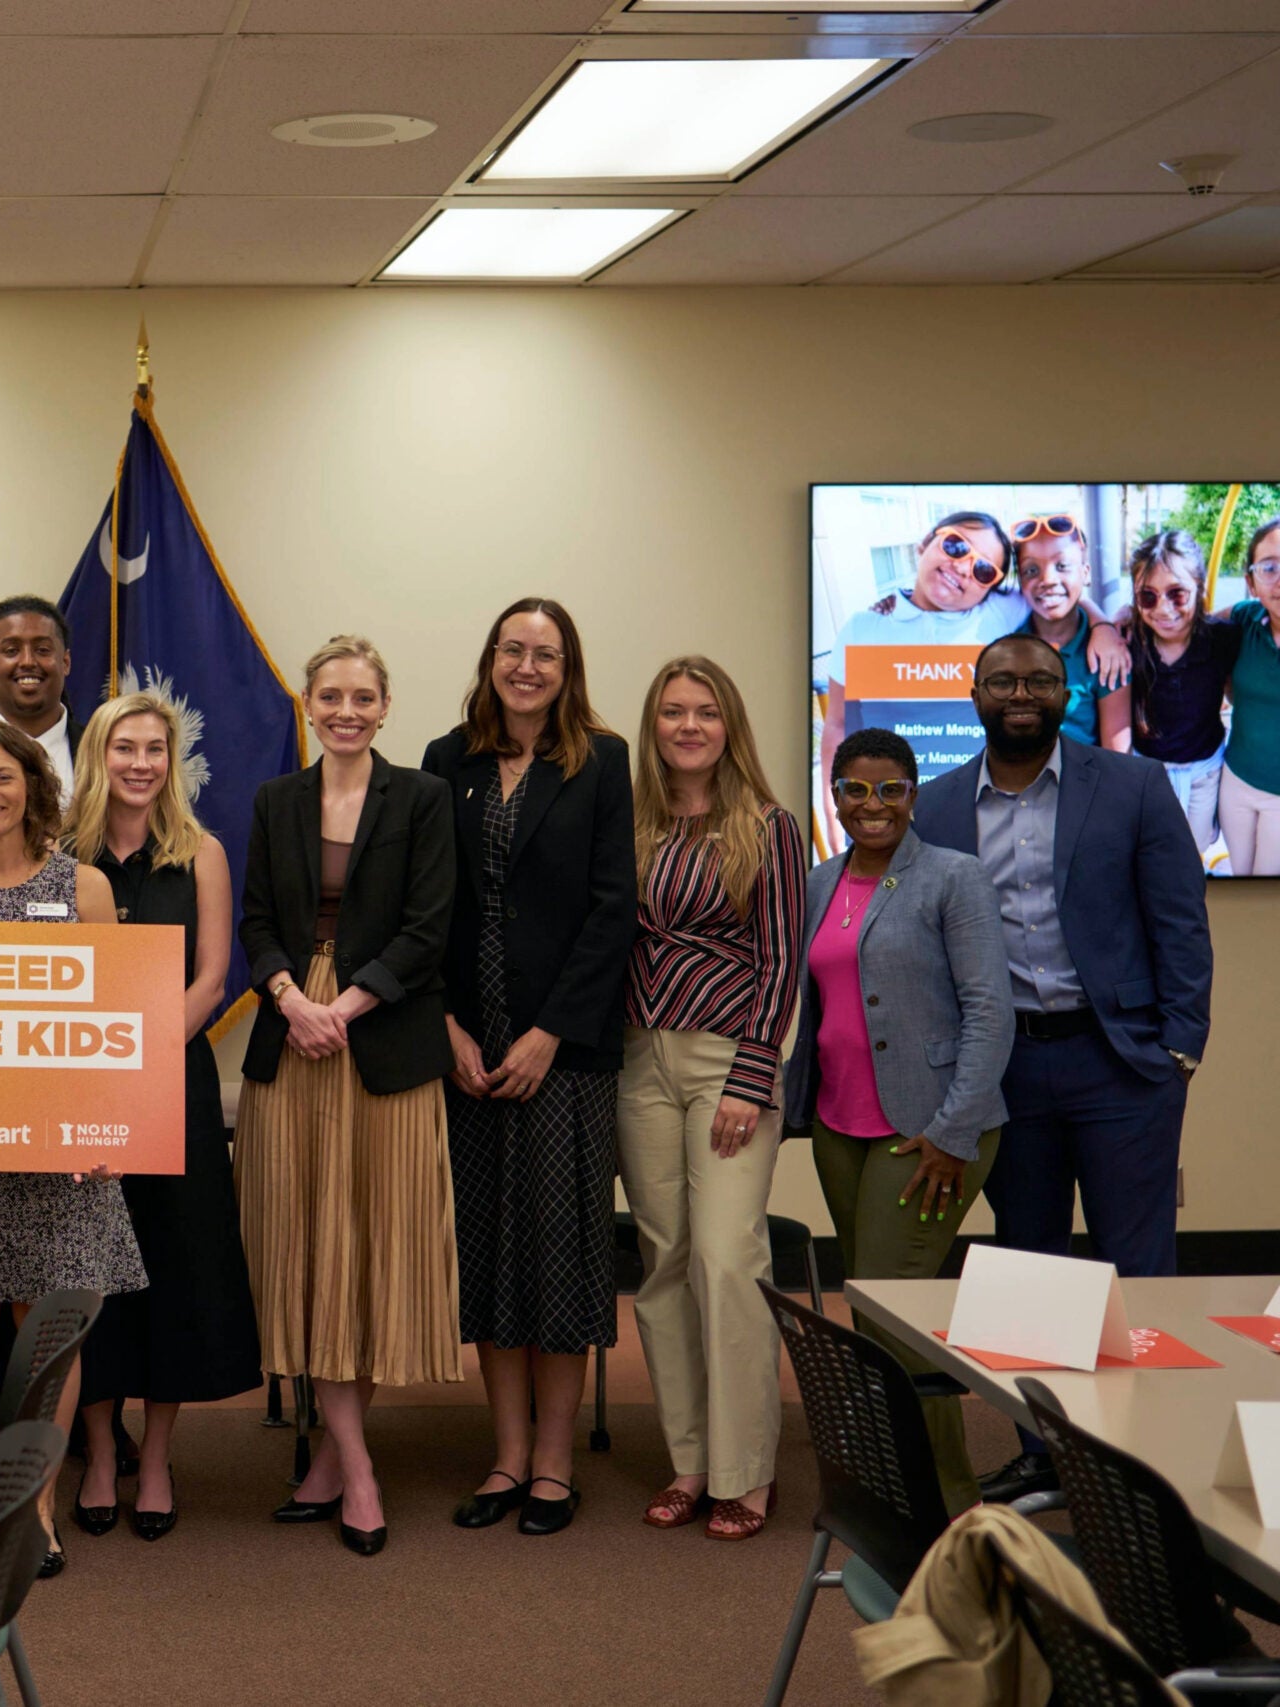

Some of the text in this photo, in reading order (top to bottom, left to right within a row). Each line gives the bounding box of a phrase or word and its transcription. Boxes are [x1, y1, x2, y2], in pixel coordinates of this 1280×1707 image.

[892, 663, 964, 681] THANK
[894, 723, 943, 736] Mathew
[17, 1021, 136, 1059] KIDS
[77, 1123, 130, 1137] NO KID
[76, 1136, 129, 1147] HUNGRY
